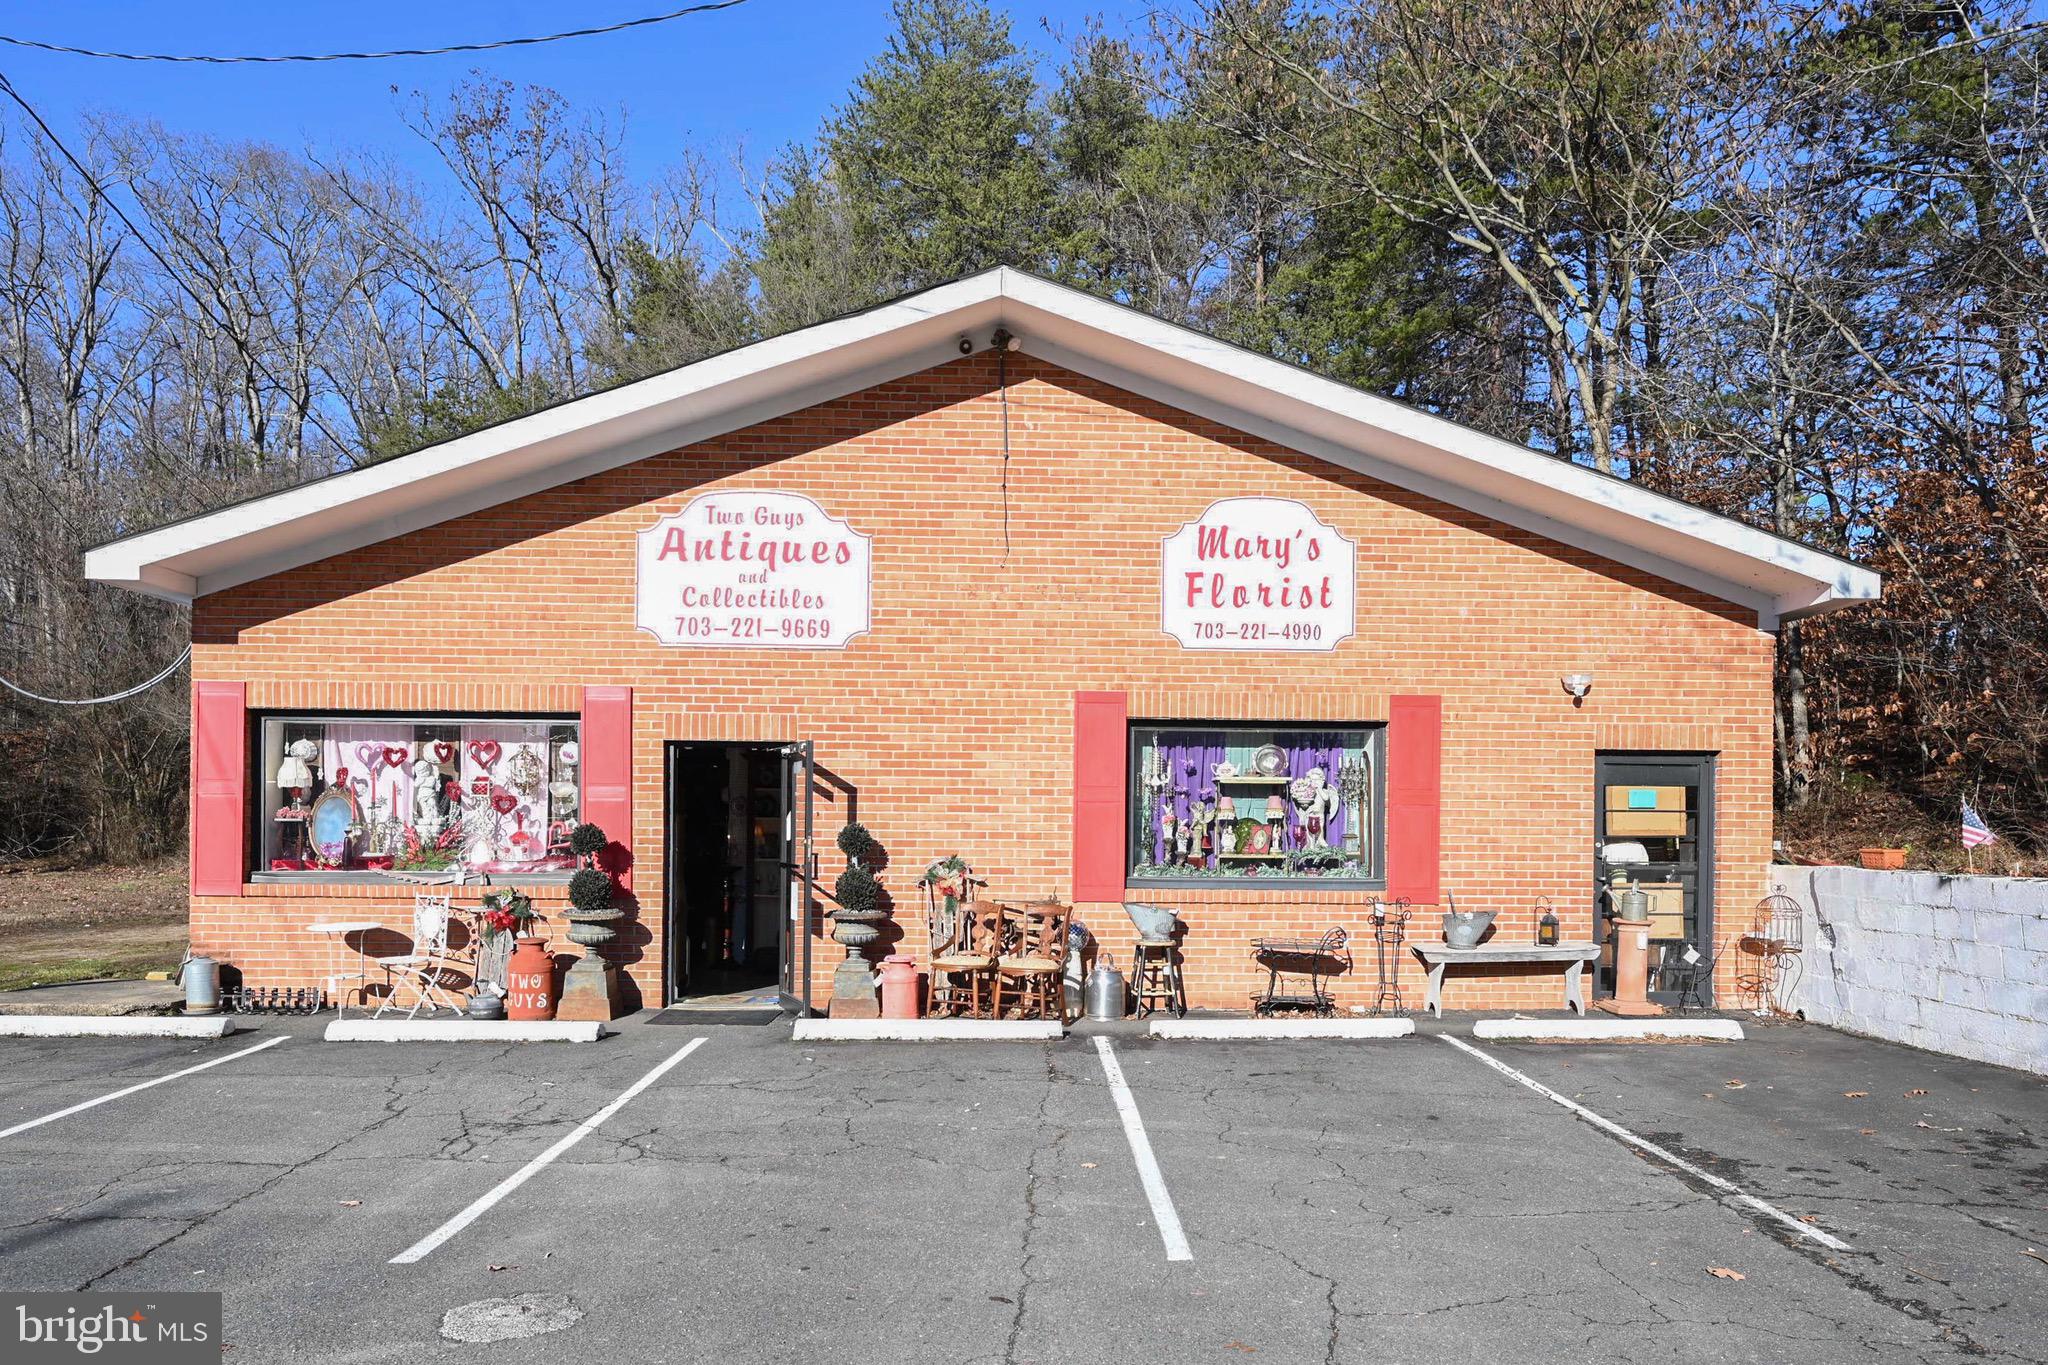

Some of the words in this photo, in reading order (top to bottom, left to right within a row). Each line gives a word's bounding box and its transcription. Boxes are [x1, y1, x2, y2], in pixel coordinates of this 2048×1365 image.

[705, 504, 745, 526] Two
[754, 506, 805, 530] Guys
[657, 526, 852, 572] Antiques
[1197, 524, 1321, 569] Mary's
[738, 568, 770, 584] and
[682, 585, 825, 610] Collectibles
[1184, 571, 1333, 609] Florist
[675, 616, 831, 639] 703-221-9669
[1193, 622, 1322, 641] 703-221-4990
[510, 973, 542, 990] TWO
